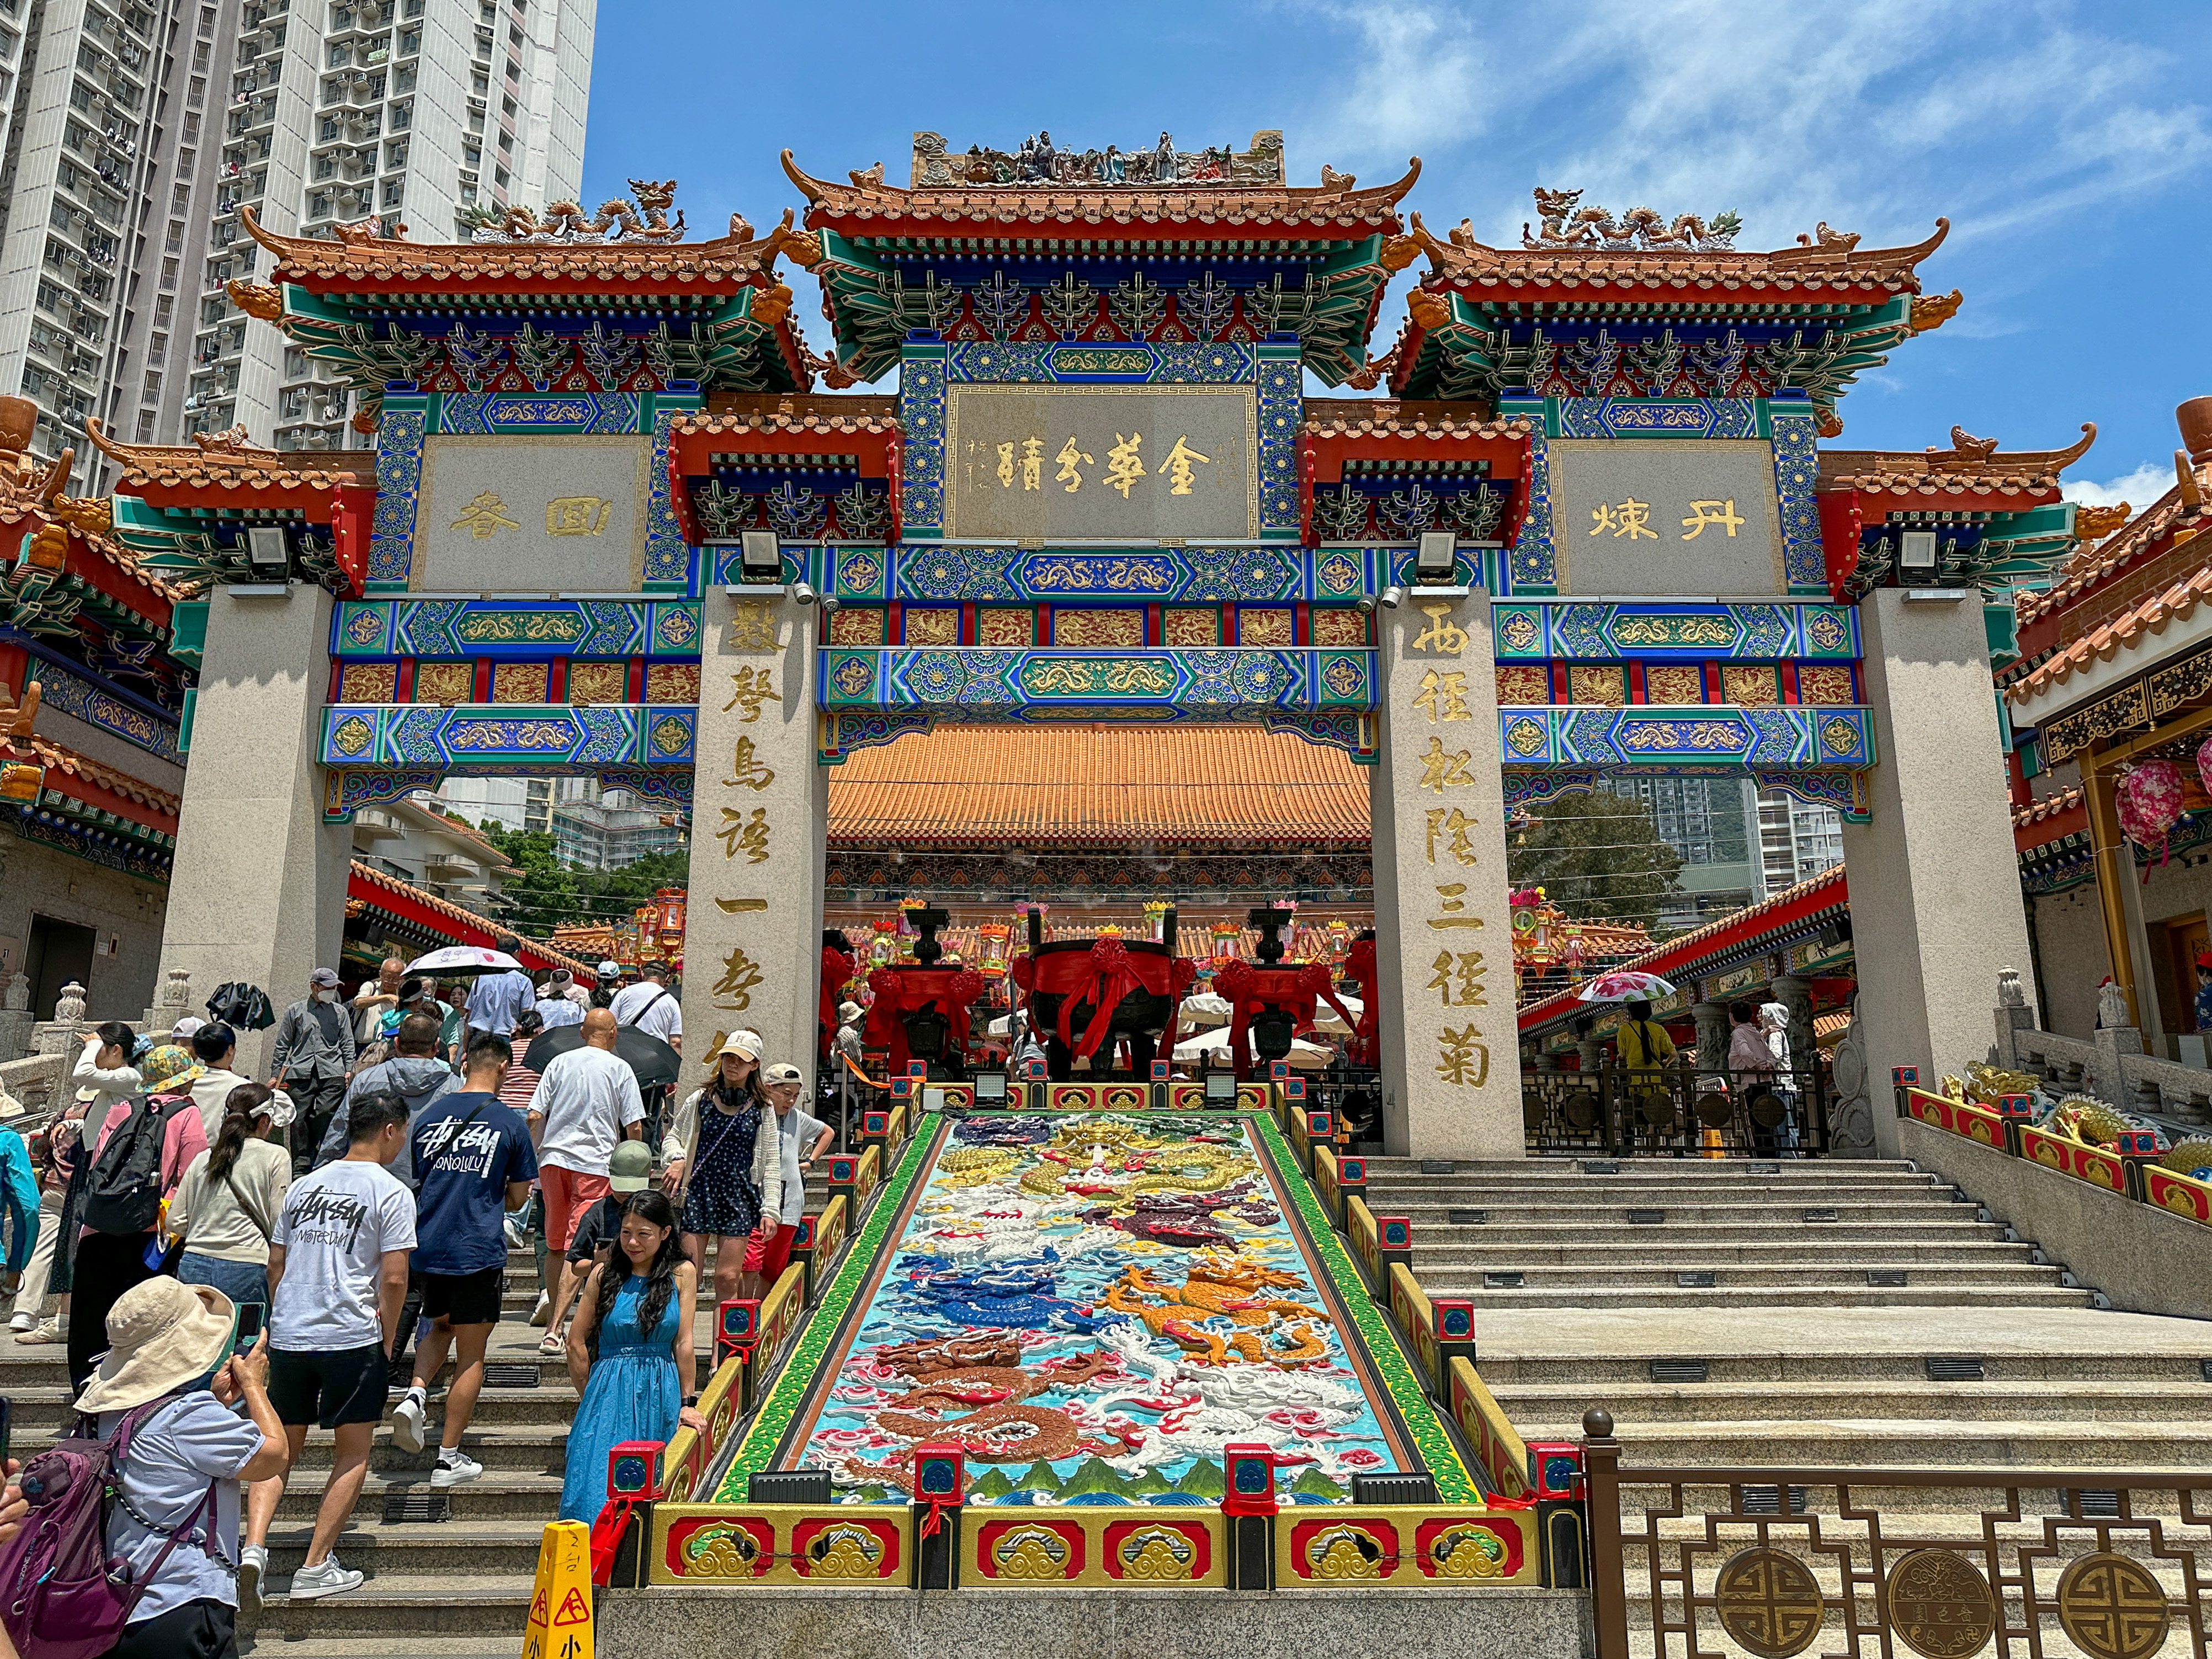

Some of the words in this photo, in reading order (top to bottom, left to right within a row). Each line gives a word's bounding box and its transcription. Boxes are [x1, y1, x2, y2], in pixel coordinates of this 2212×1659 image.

[736, 1035, 746, 1044] H
[17, 1556, 31, 1591] AIRZONE
[528, 1634, 540, 1659] 小
[560, 1634, 581, 1659] 小
